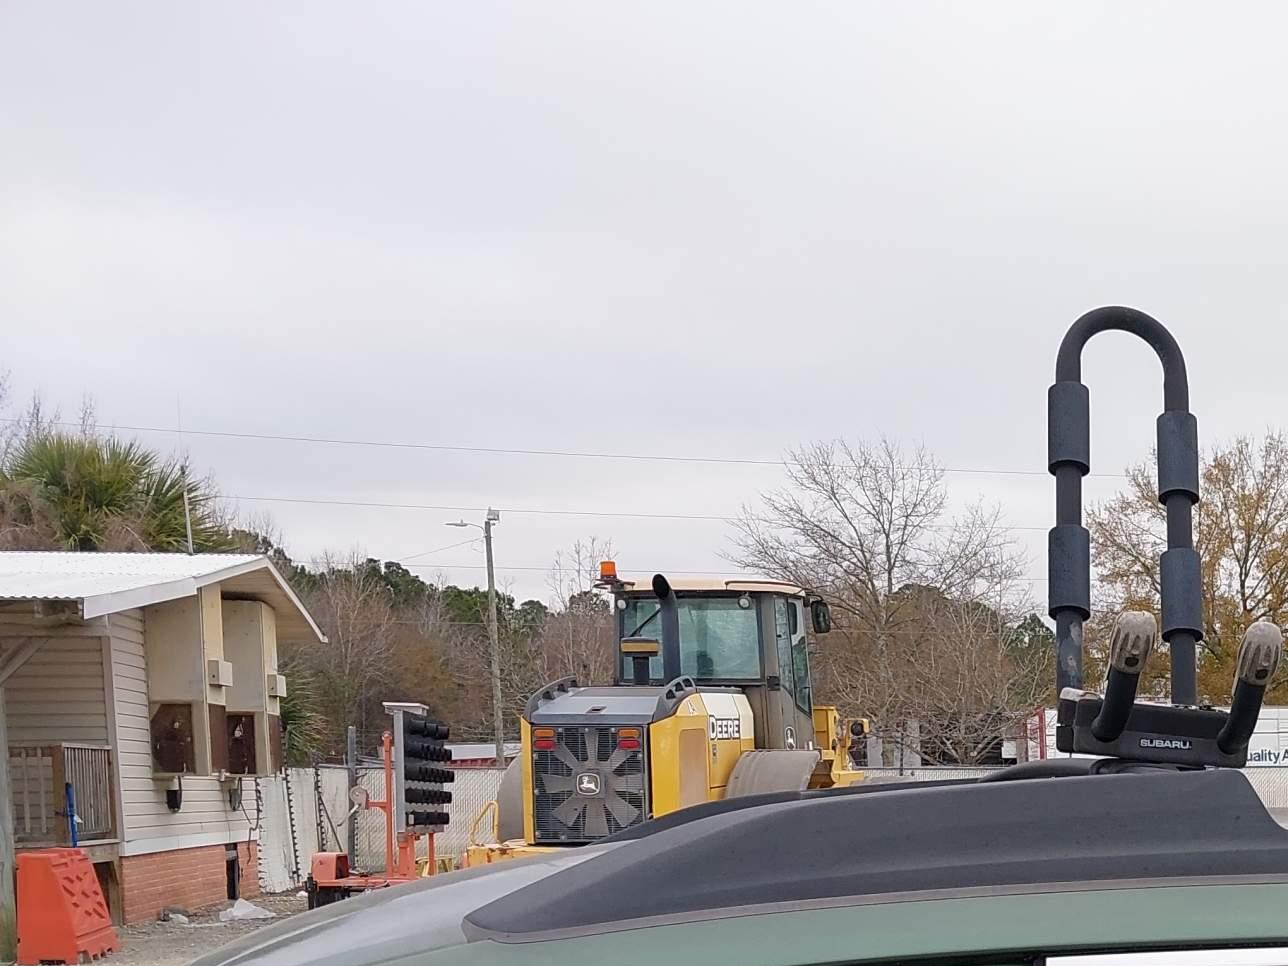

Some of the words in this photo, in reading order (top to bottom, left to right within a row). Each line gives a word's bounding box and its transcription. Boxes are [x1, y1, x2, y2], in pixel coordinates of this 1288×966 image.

[709, 715, 740, 740] DEERE
[1140, 739, 1190, 749] SUBARU
[1247, 749, 1281, 764] uality
